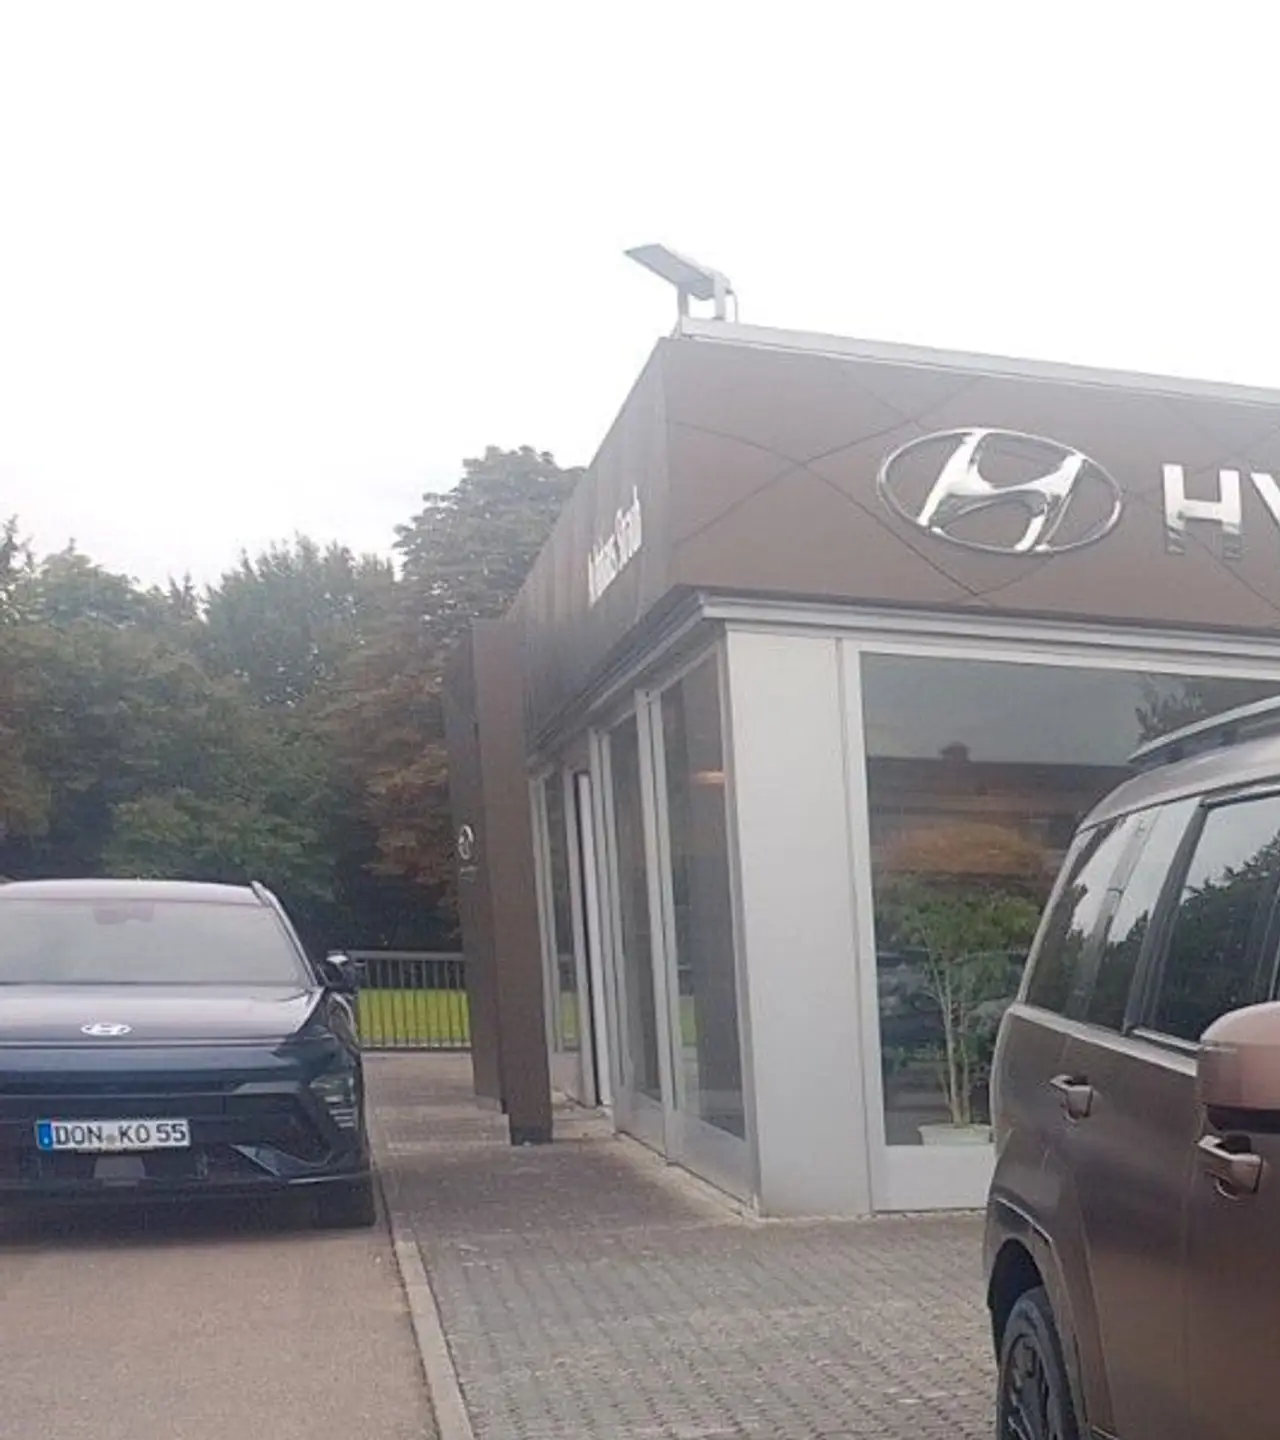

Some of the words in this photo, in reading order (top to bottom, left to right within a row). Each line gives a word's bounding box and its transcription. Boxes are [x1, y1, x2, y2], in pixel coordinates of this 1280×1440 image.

[55, 1125, 102, 1146] DON
[117, 1124, 150, 1145] KO
[156, 1123, 186, 1142] 55
